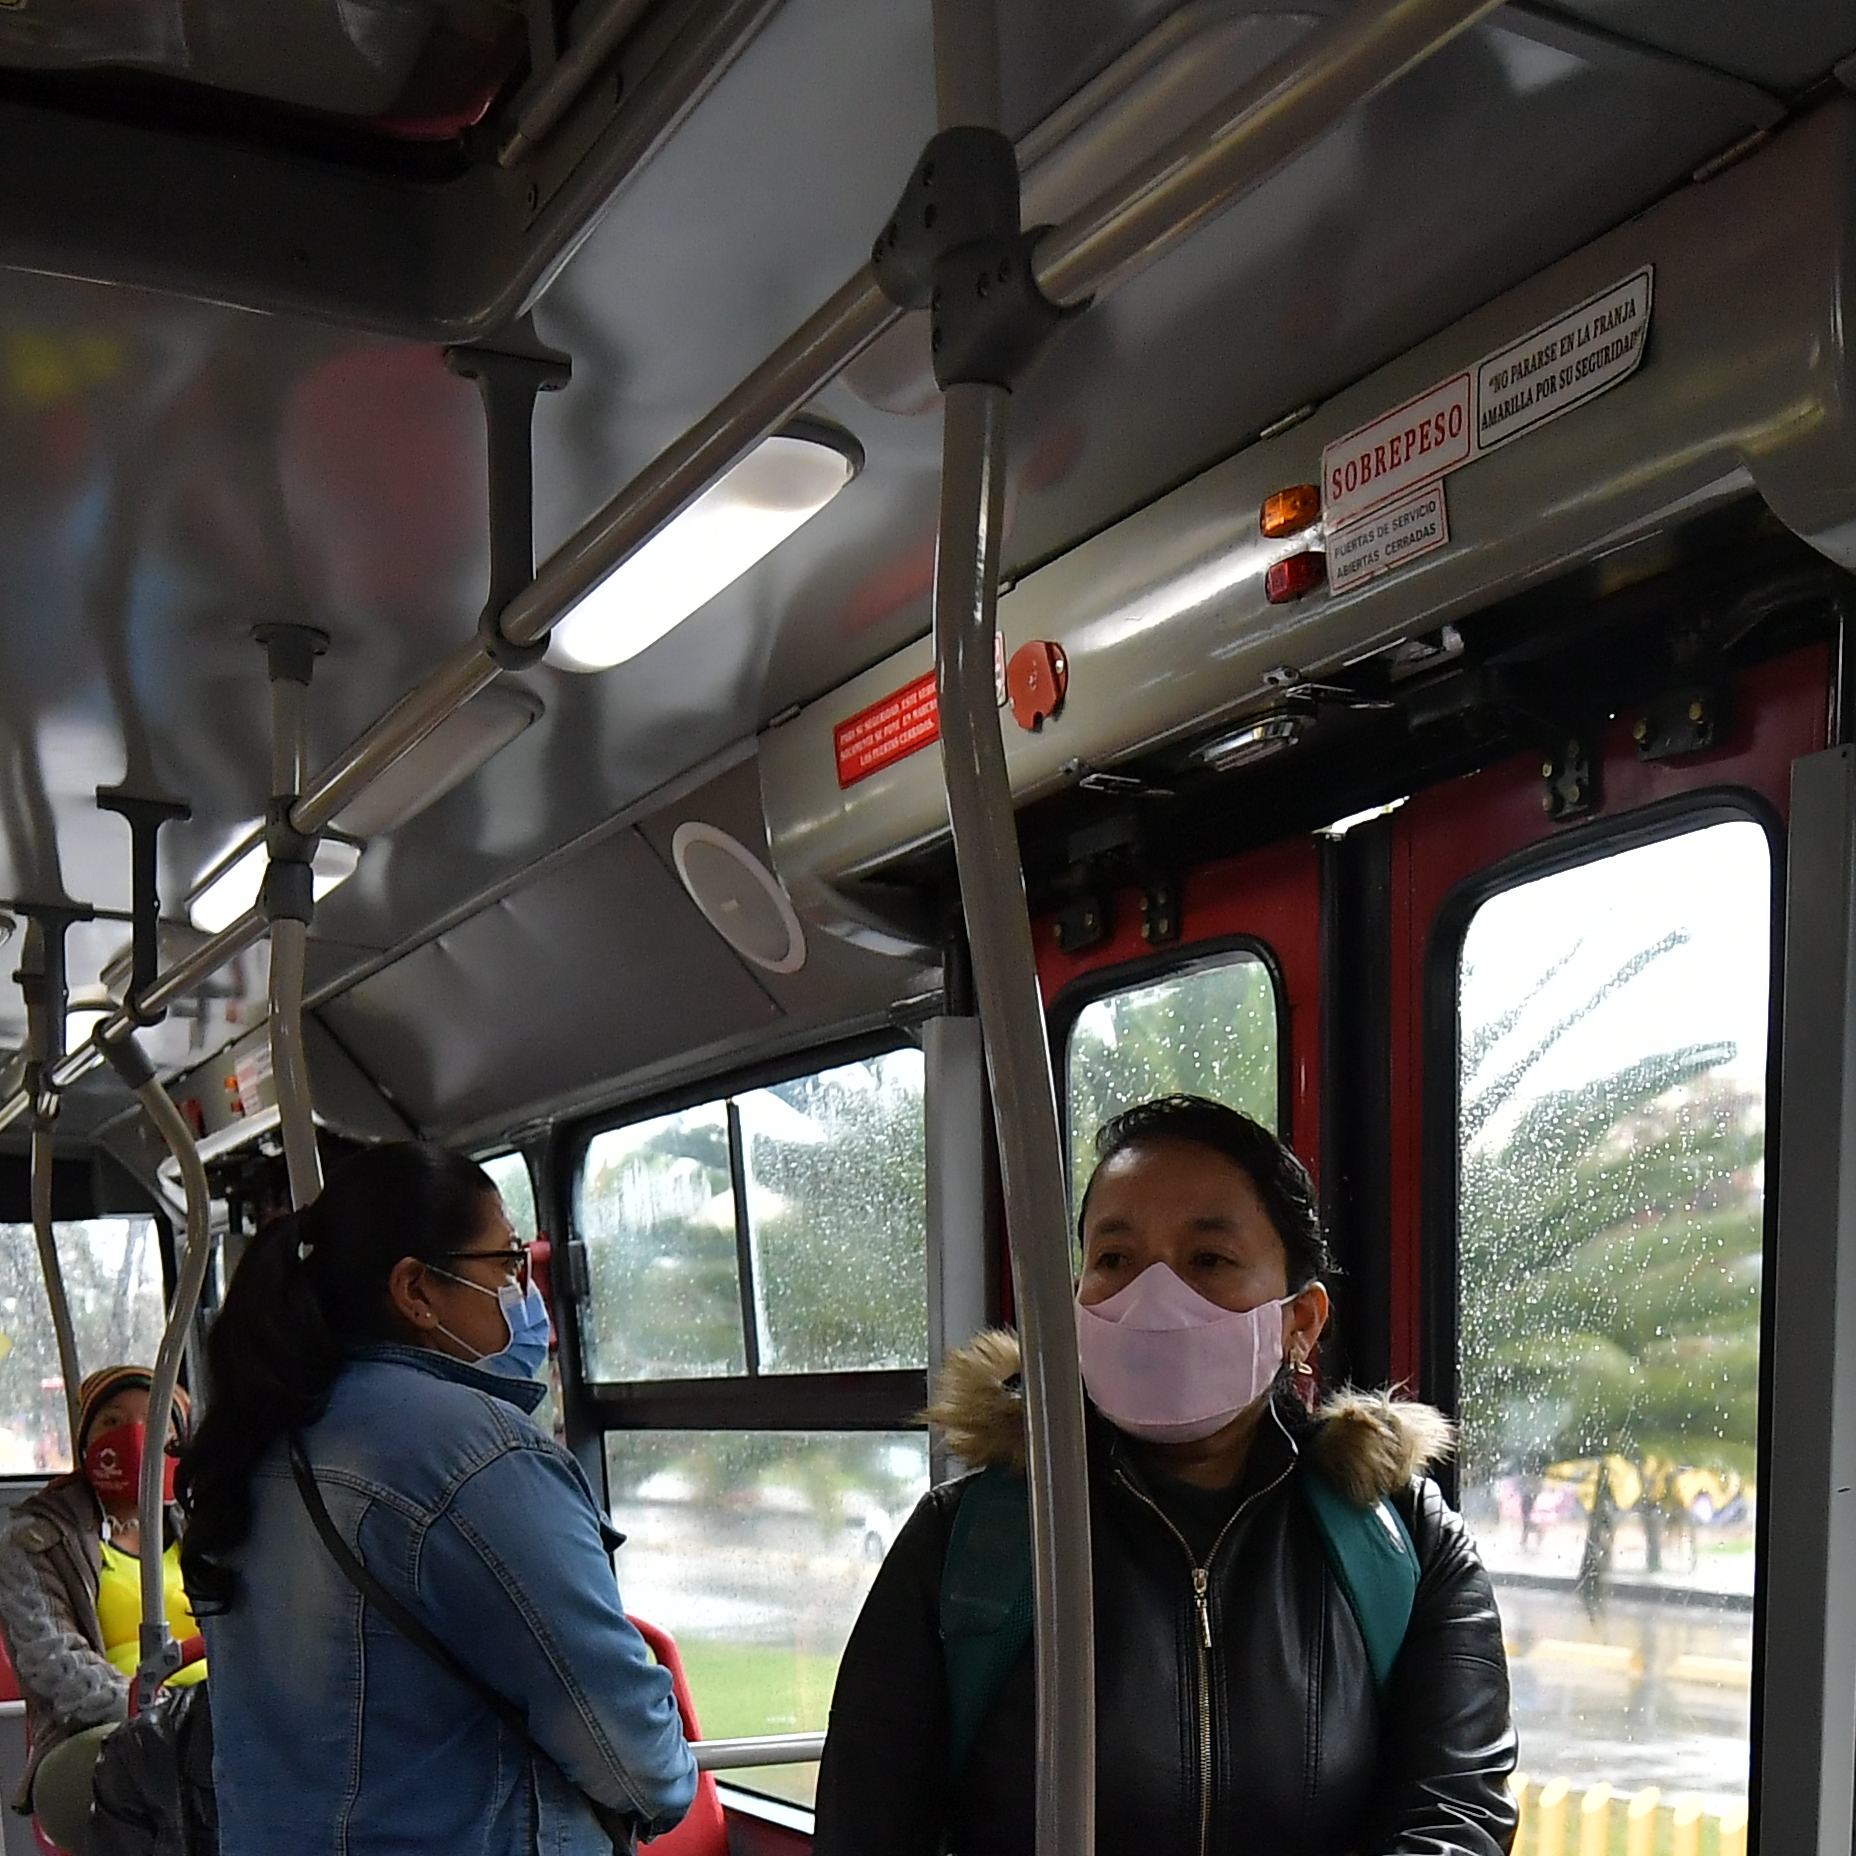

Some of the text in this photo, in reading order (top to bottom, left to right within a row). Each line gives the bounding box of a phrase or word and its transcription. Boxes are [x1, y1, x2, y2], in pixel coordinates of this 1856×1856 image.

[1511, 346, 1556, 384] PARARSE
[1560, 334, 1575, 356] EN
[1577, 323, 1591, 346] LA
[1593, 298, 1636, 338] FRANJA
[1481, 390, 1533, 430] AMARILLA
[1536, 375, 1556, 401] POR
[1559, 365, 1574, 389] SU
[1331, 403, 1463, 499] SOBREPESO
[1334, 500, 1436, 558] PUERTAS DE SERVICIO
[1384, 522, 1436, 556] CERRADAS
